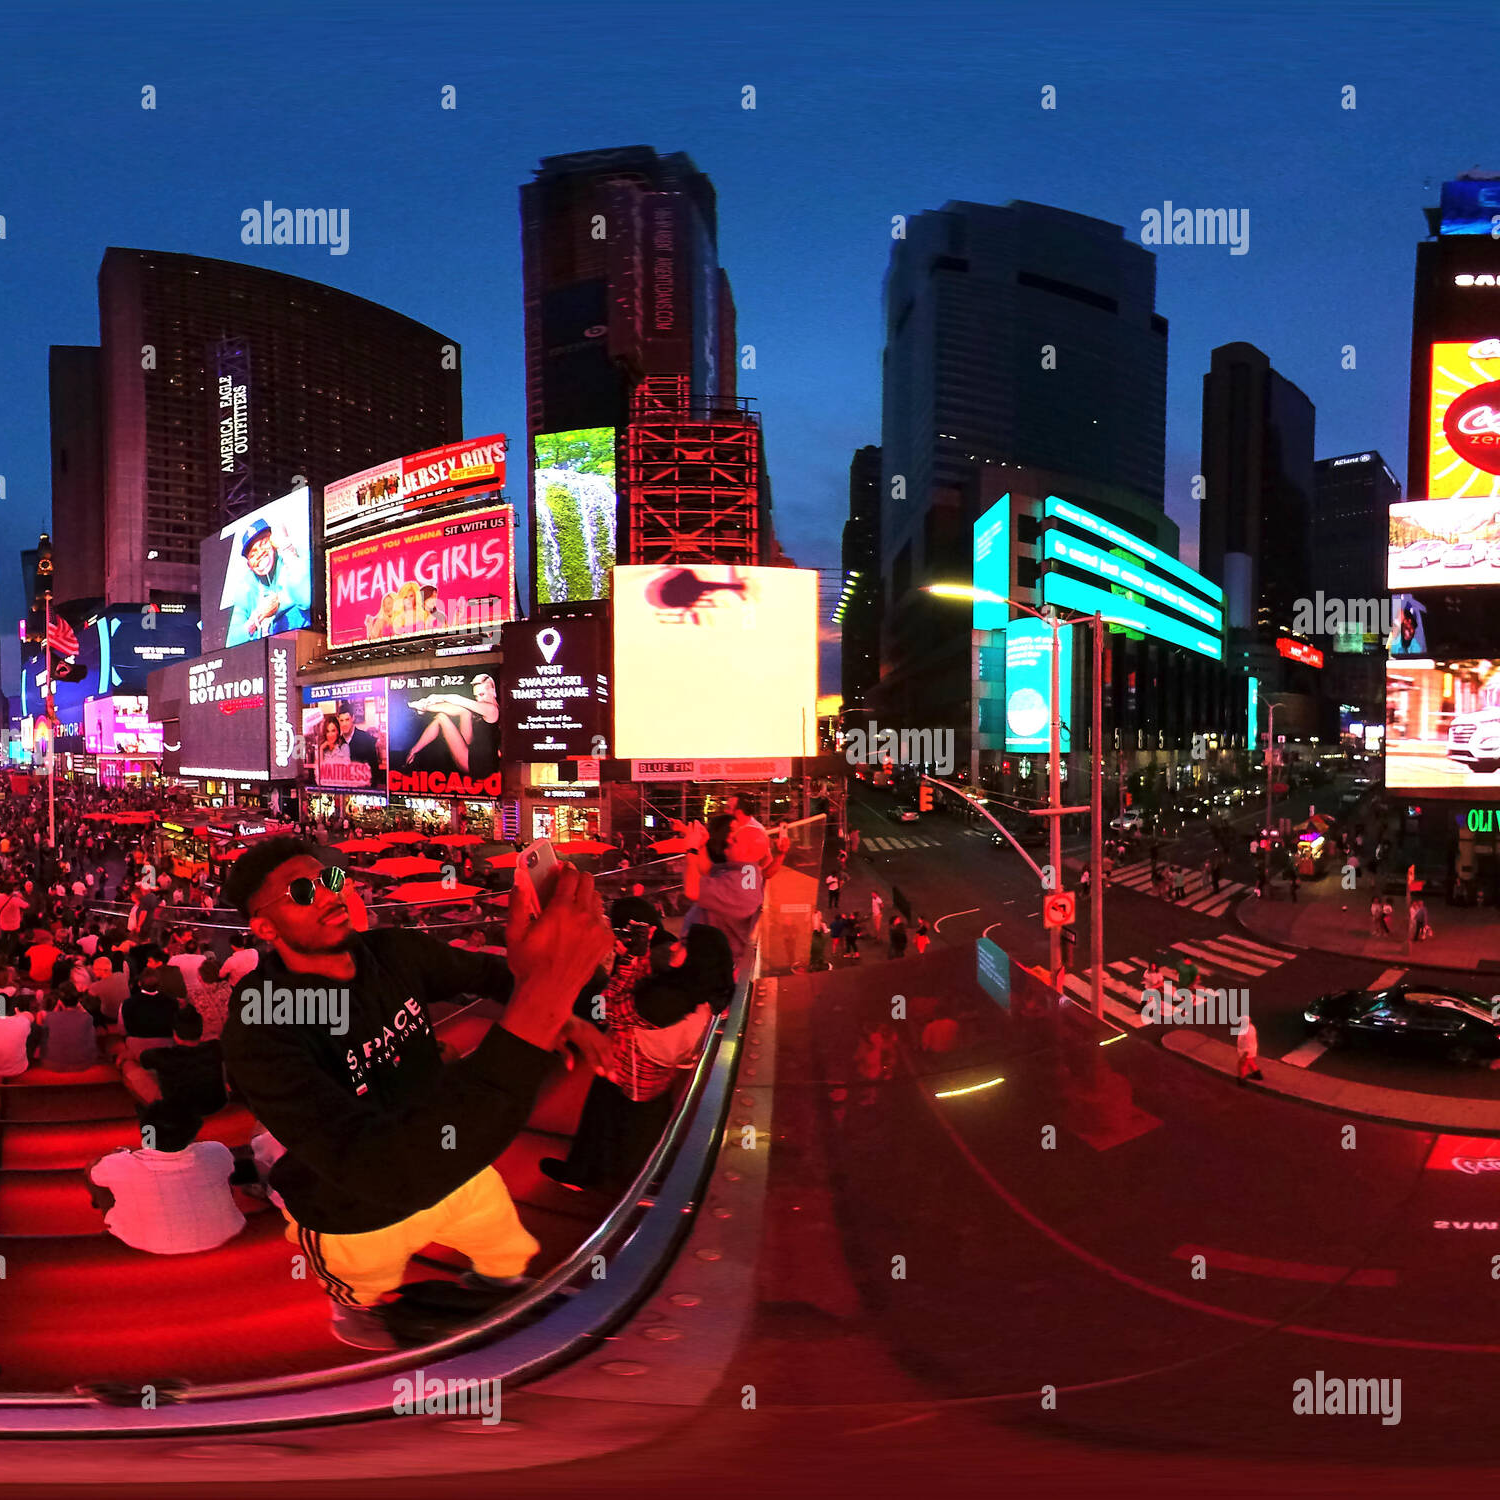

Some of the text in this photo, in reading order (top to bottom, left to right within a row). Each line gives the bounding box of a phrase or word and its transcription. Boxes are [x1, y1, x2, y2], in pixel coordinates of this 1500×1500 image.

[219, 375, 234, 472] AMERICA EAGLE
[233, 385, 248, 454] OUTFITTERS
[402, 456, 456, 495] JERSEY
[461, 442, 506, 469] BOYS
[333, 517, 504, 563] YOU KNOW YOU WANNA SIT WITH US
[336, 538, 504, 608] MEAN GIRLS
[535, 665, 563, 675] VISIT
[189, 671, 215, 689] RAP
[390, 674, 465, 689] AND ALL THAT JAZZ
[518, 676, 583, 687] SWAROVSKI
[189, 677, 263, 704] ROTATION
[311, 689, 330, 698] SARA
[511, 687, 590, 699] TIMES SQUARE
[270, 648, 292, 767] amazon music
[536, 700, 564, 710] HERE
[320, 763, 371, 781] WAITRESS
[639, 761, 693, 773] BLUE FIN
[388, 770, 502, 796] CHICAGO
